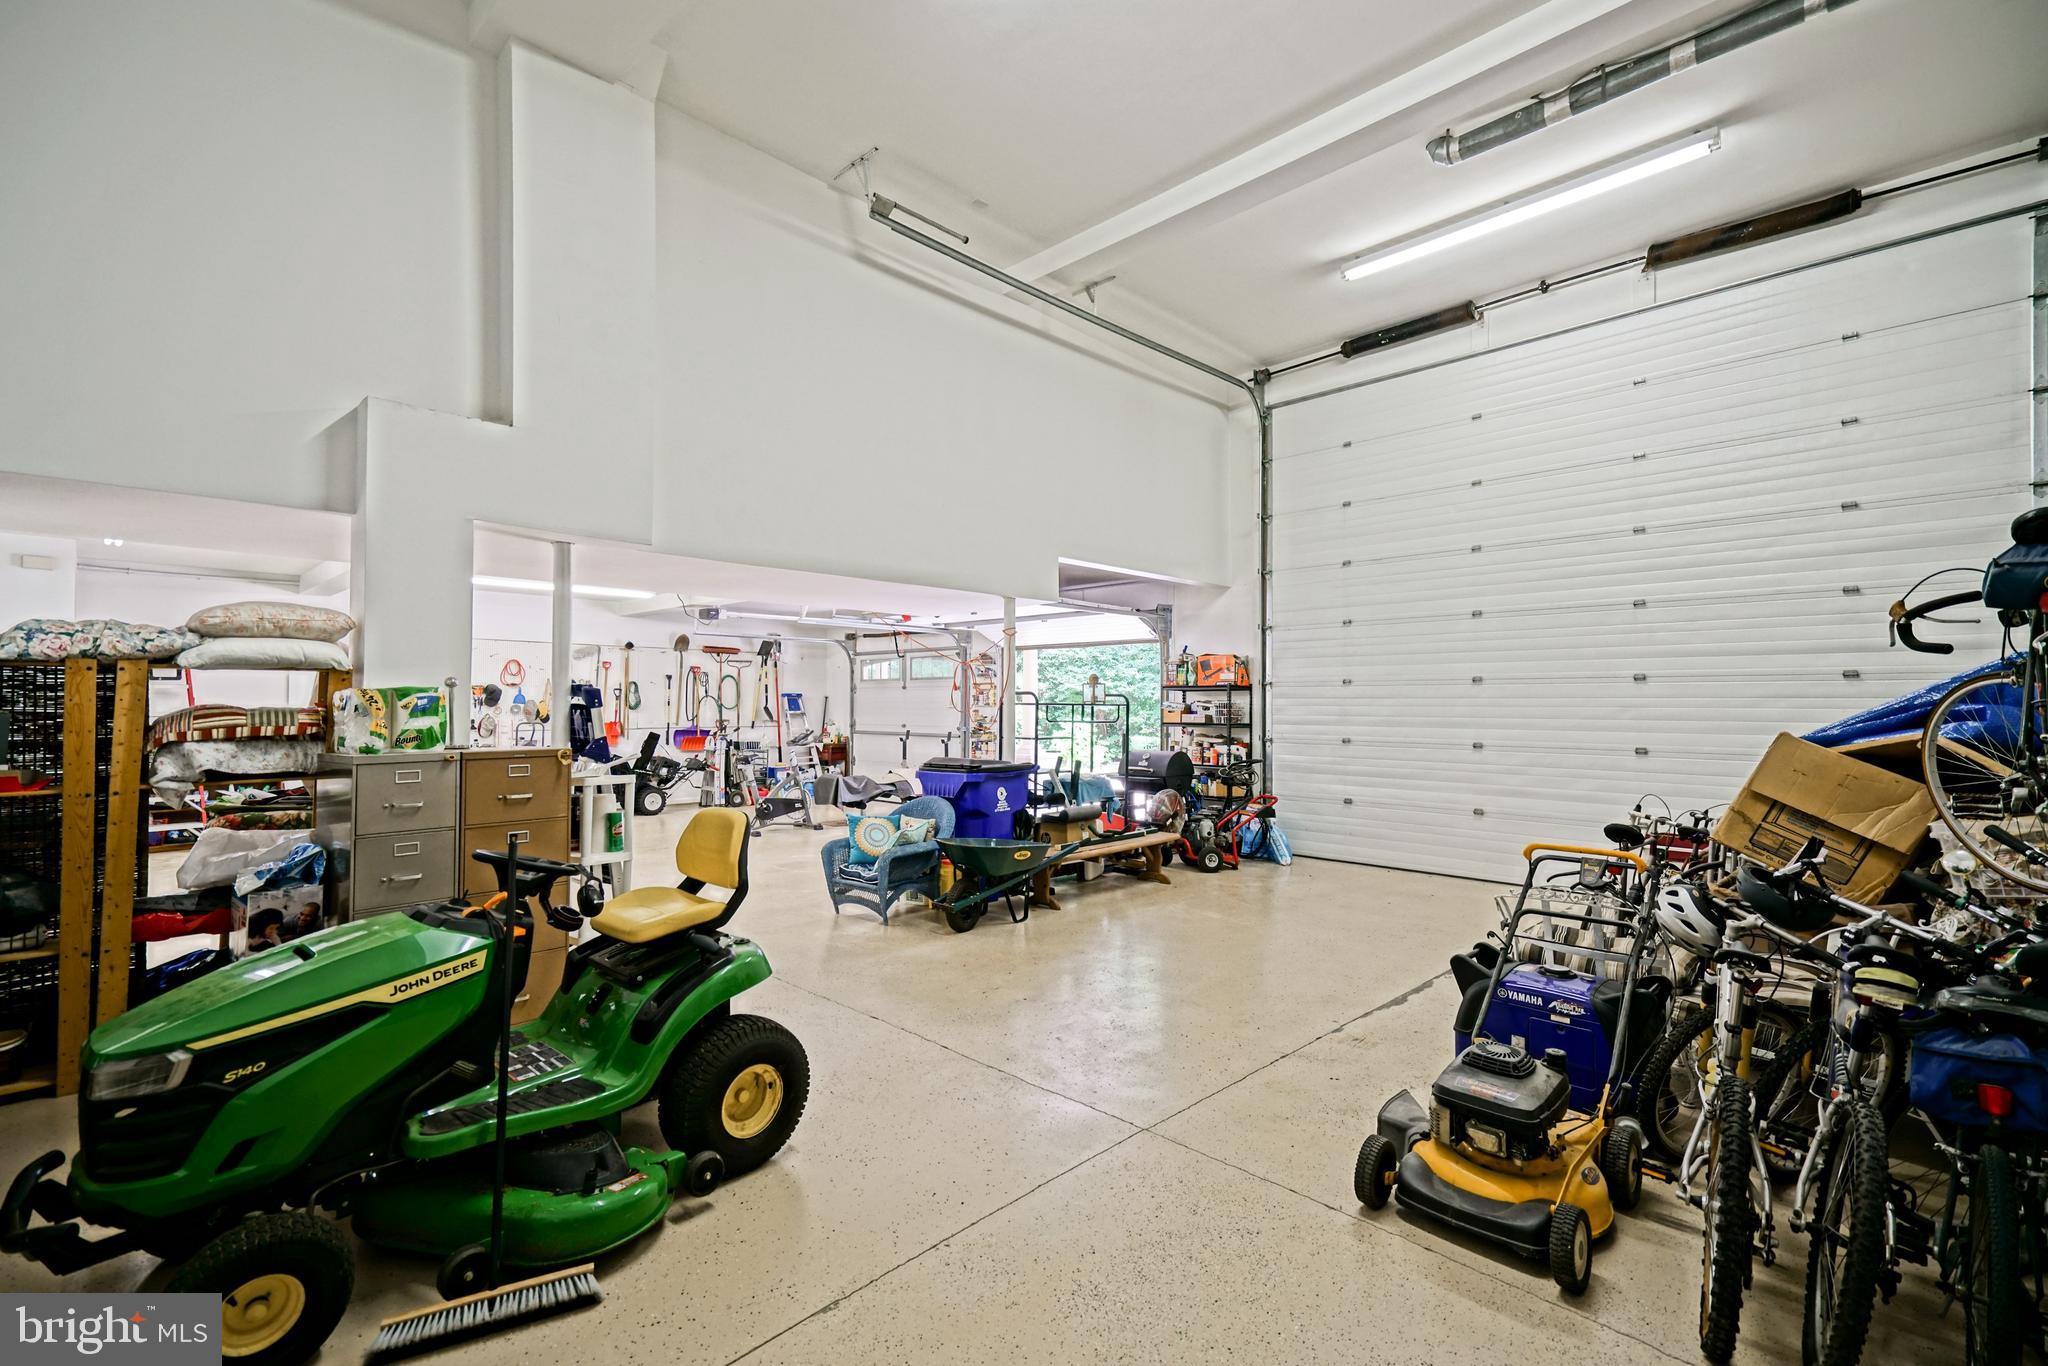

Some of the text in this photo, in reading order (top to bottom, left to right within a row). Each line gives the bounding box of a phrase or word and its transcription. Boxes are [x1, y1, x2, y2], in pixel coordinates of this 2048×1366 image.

[395, 735, 422, 747] Bounty
[390, 959, 478, 997] JOHN DEERE
[1507, 990, 1543, 1006] YAMAHA
[222, 1061, 266, 1084] S140
